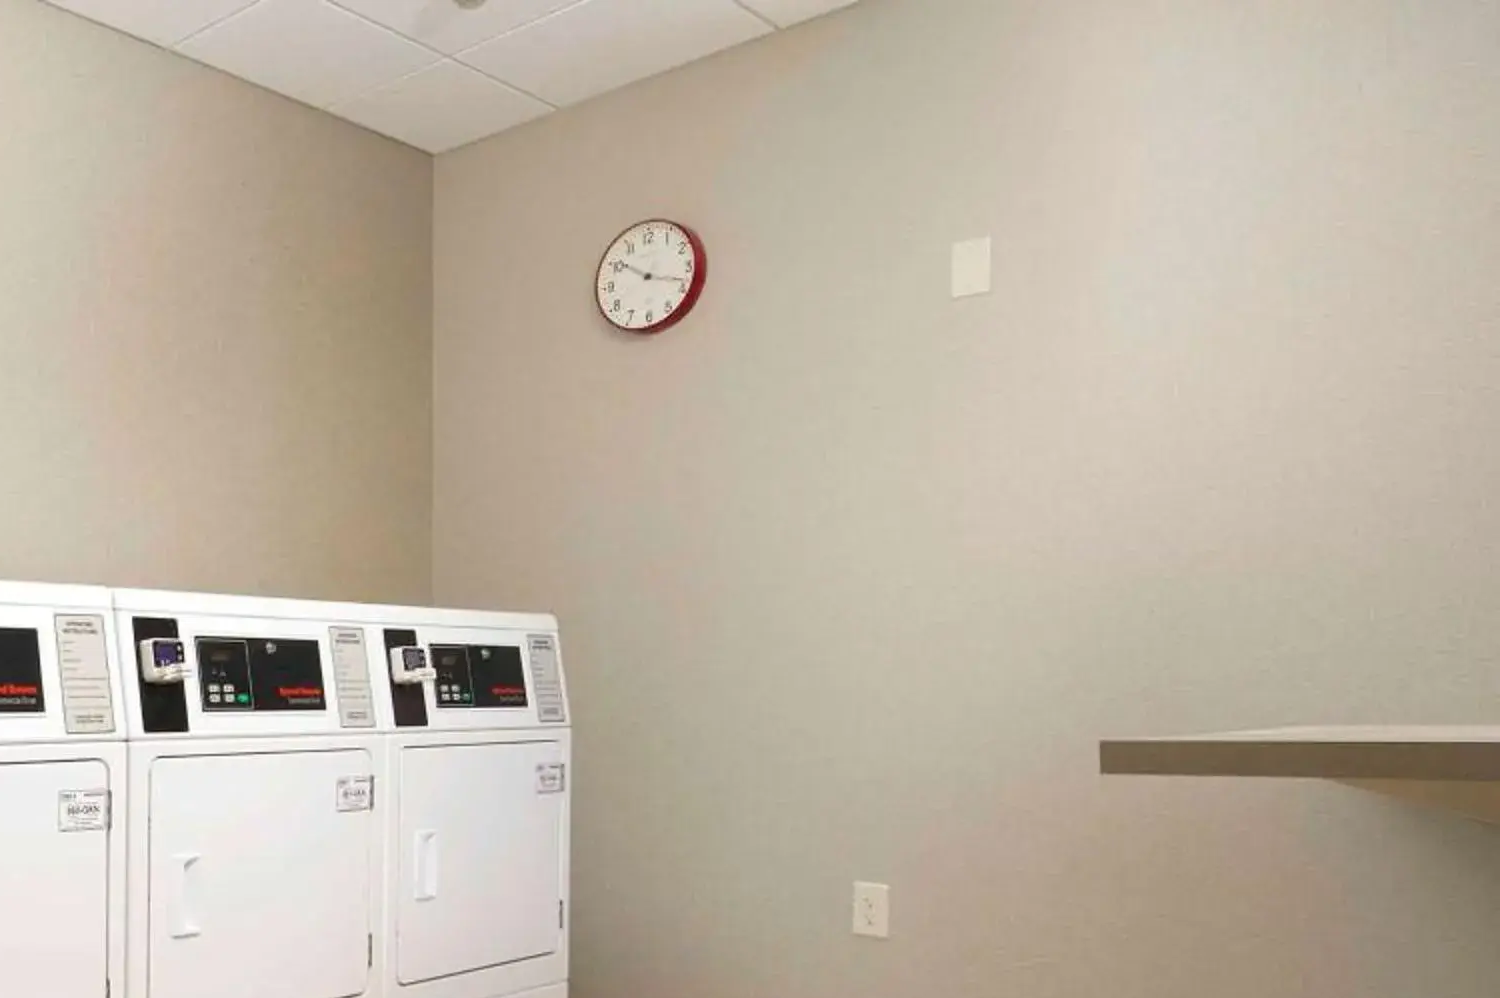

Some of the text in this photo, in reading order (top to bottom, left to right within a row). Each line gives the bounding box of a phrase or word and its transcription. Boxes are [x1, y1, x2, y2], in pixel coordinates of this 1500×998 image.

[643, 231, 655, 246] 12
[624, 239, 636, 255] 11
[677, 241, 687, 255] 2
[685, 260, 694, 273] 3
[607, 281, 615, 293] 9
[613, 299, 621, 313] 8
[664, 300, 673, 313] 5
[627, 309, 636, 321] 7
[645, 309, 653, 323] 6
